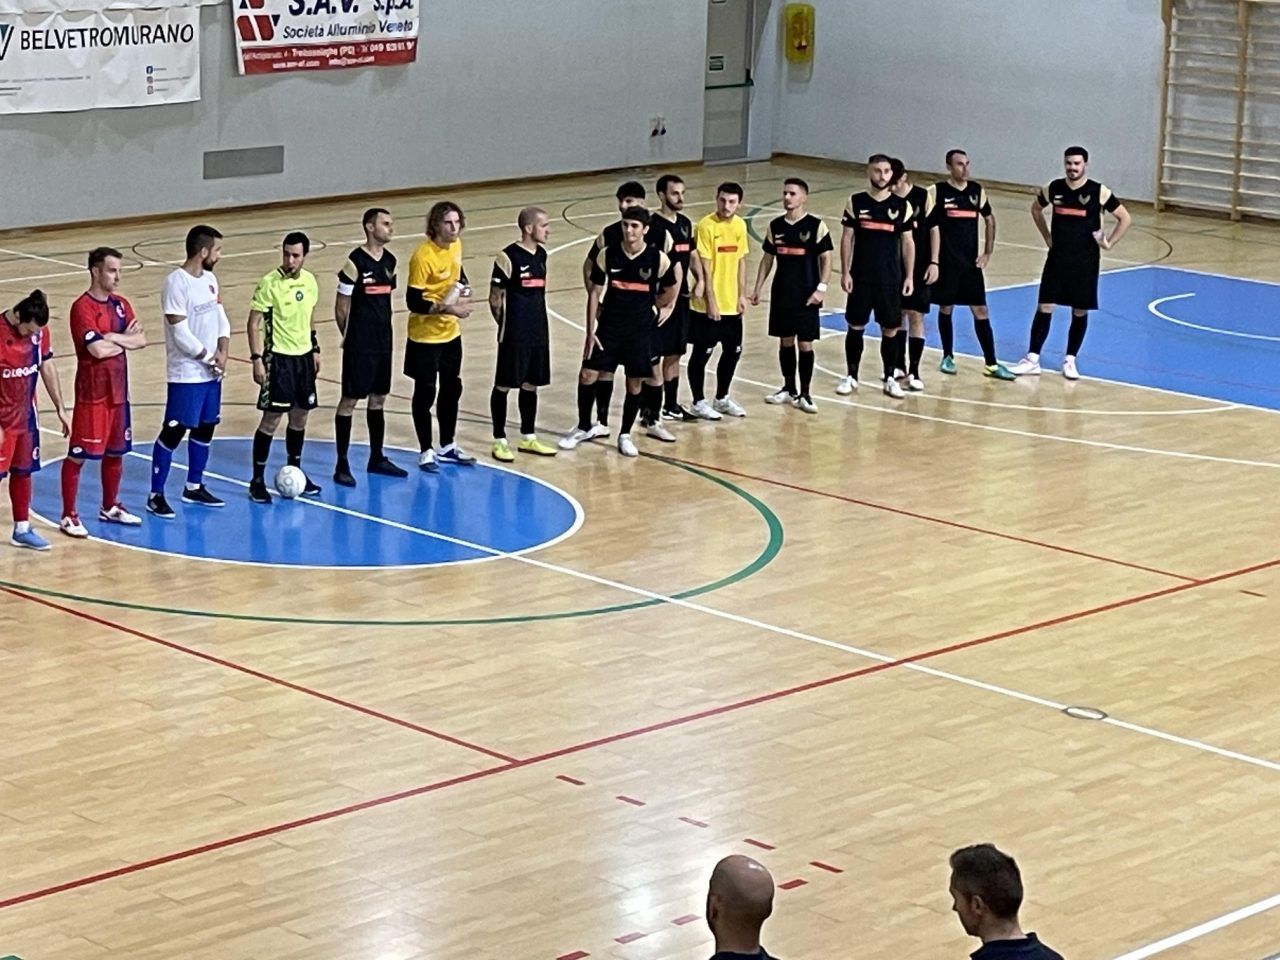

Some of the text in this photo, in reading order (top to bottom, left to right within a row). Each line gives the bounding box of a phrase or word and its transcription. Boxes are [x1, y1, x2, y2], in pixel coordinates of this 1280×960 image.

[20, 23, 194, 51] BELVETROMURANO
[327, 22, 376, 37] Alluminio
[379, 19, 413, 33] Veneto
